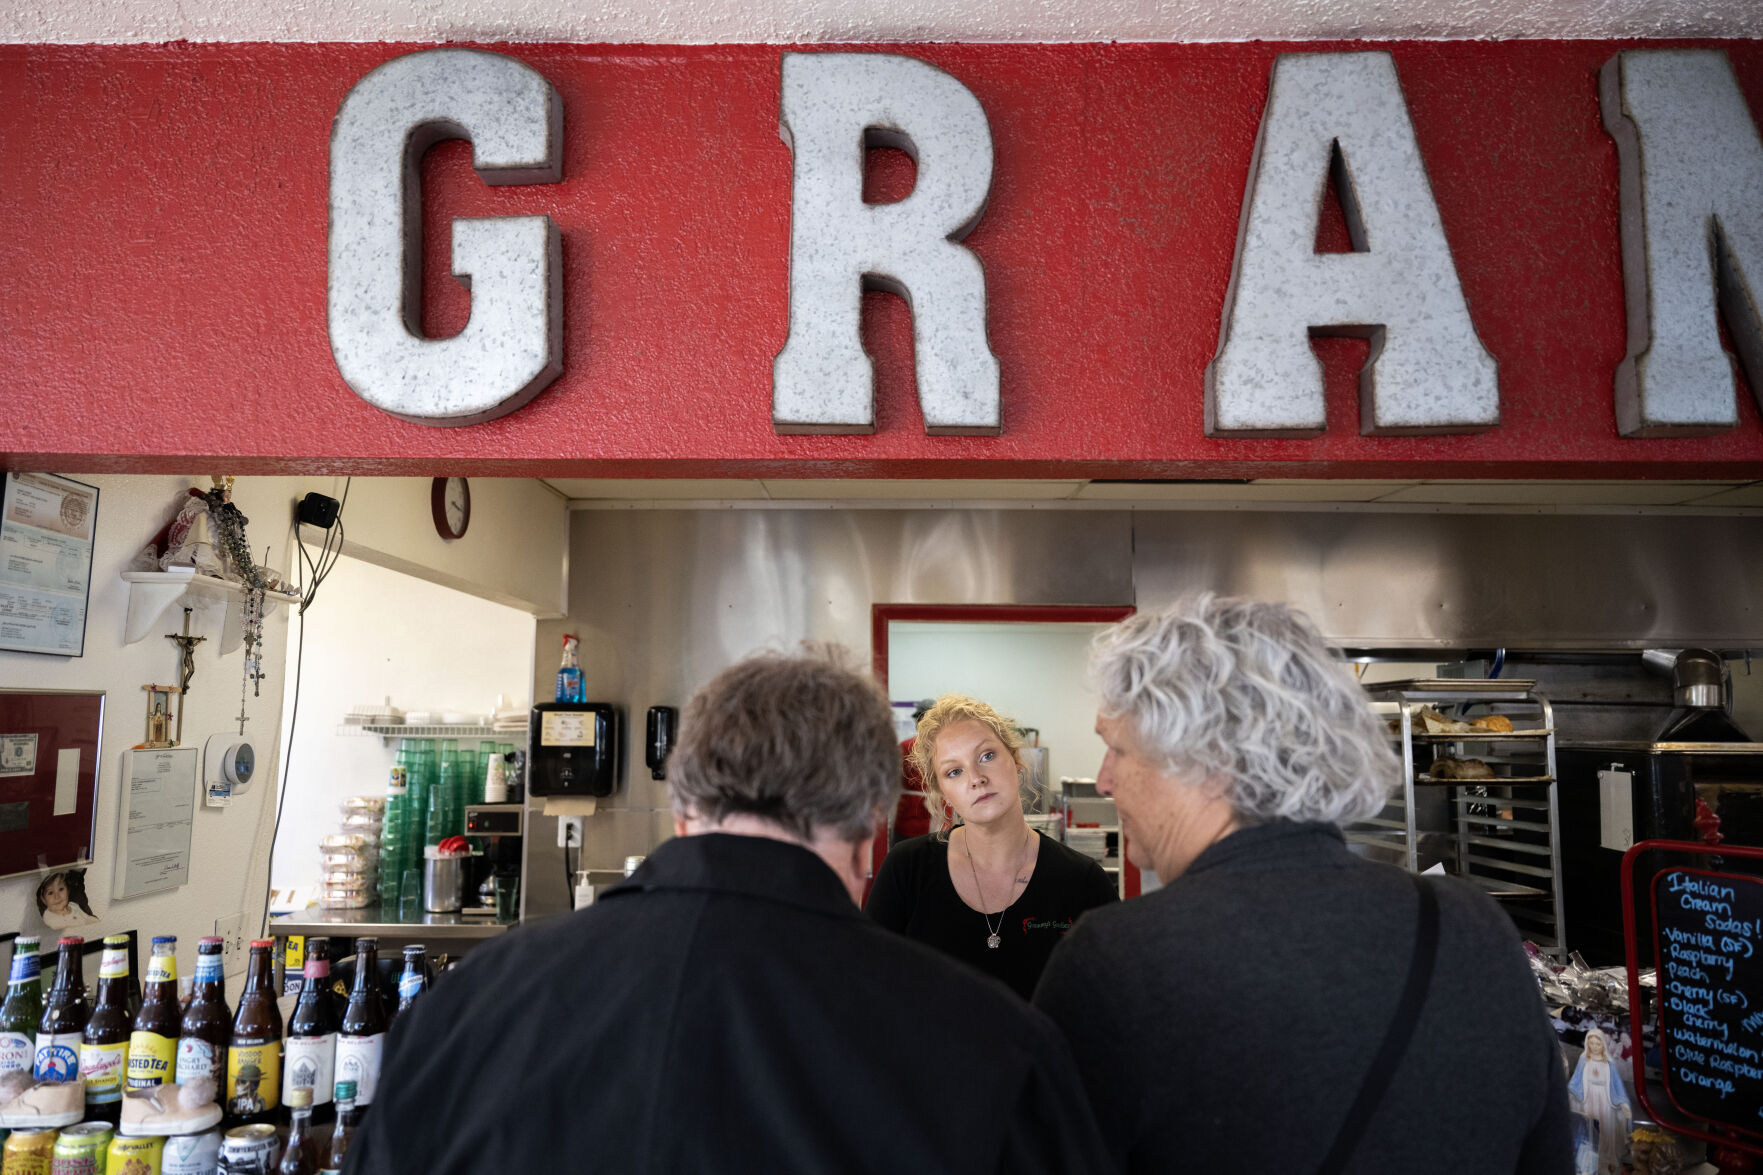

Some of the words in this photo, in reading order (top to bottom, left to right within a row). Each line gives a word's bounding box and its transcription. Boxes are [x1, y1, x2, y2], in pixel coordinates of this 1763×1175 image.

[1667, 872, 1735, 902] Italian
[1681, 894, 1732, 916] Cream
[1668, 962, 1710, 984] Peach
[1670, 997, 1712, 1019] Black
[150, 1059, 168, 1071] TEA
[1675, 1045, 1705, 1066] Blue
[237, 1098, 254, 1111] IPA
